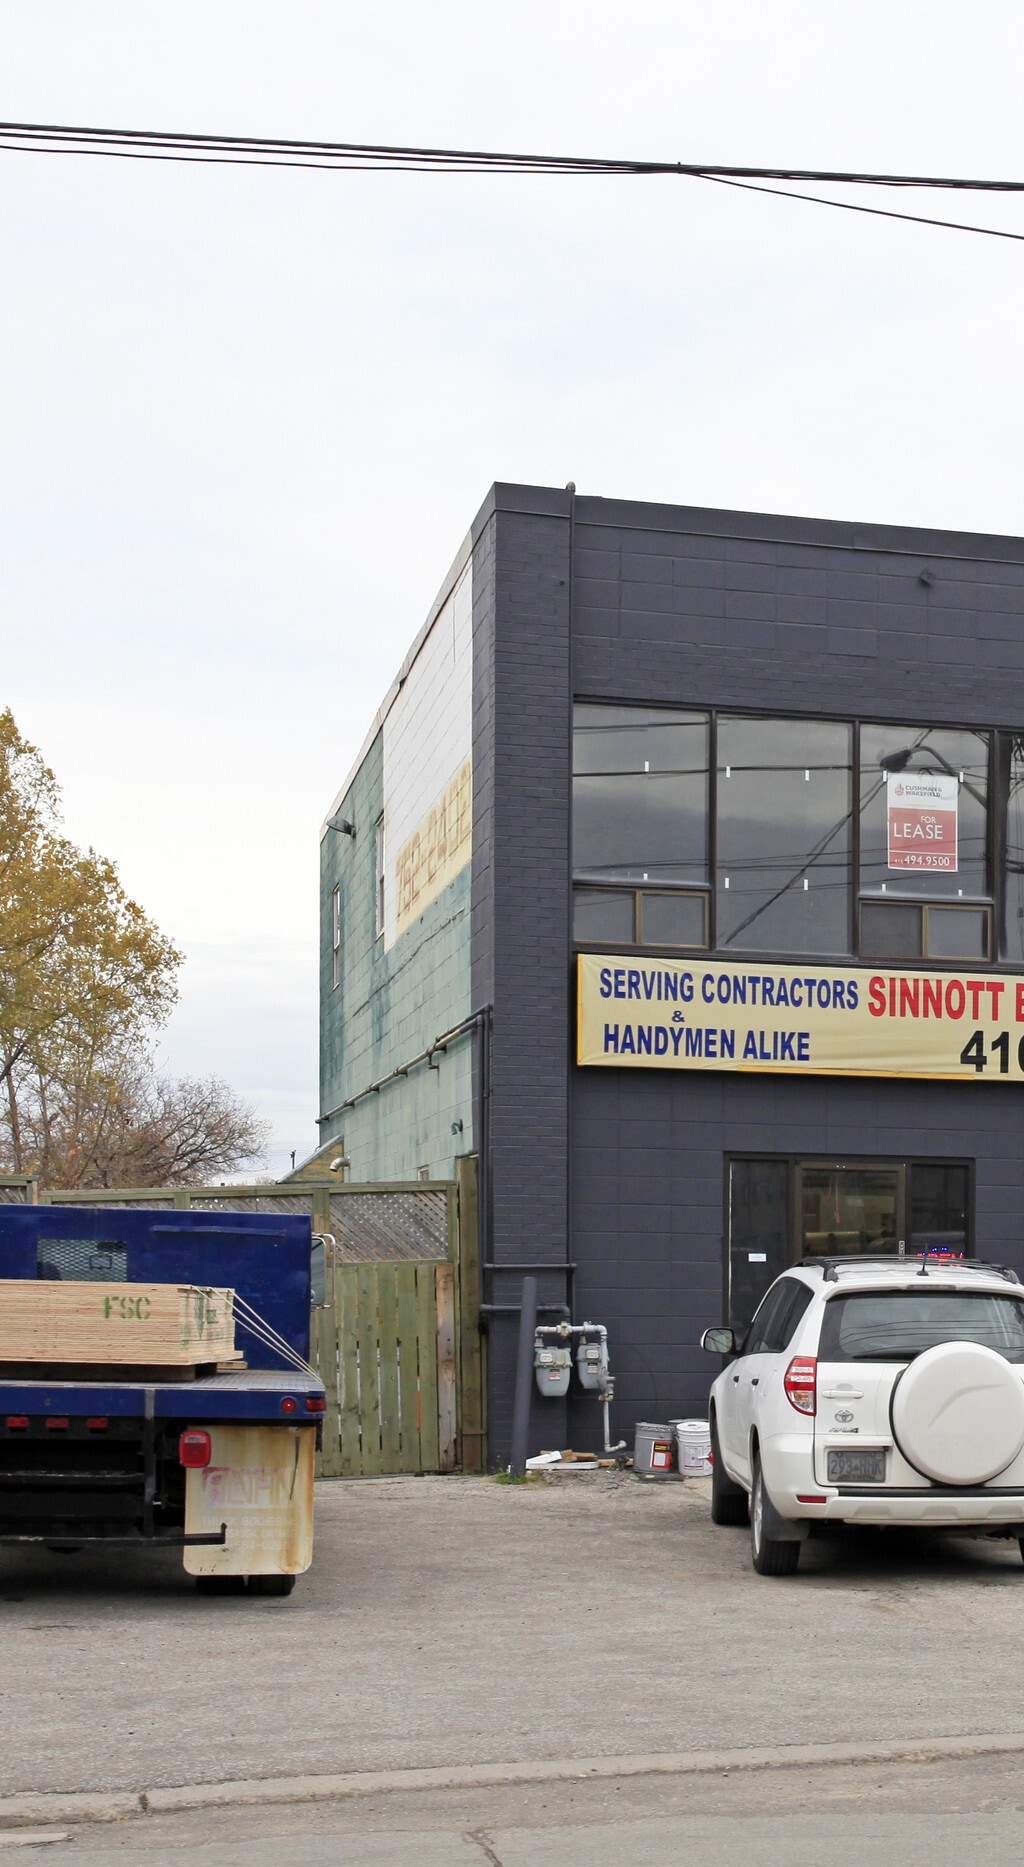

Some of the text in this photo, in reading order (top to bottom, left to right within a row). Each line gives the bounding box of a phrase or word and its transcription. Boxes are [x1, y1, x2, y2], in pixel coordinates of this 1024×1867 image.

[920, 816, 936, 824] FOR
[893, 822, 943, 840] LEASE
[904, 855, 950, 866] 494.9500
[599, 967, 859, 1010] SERVING CONTRACTORS
[867, 975, 1005, 1023] SINNOTT
[671, 1010, 686, 1023] &
[603, 1023, 811, 1062] HANDYMEN ALIKE
[103, 1295, 151, 1320] FSC
